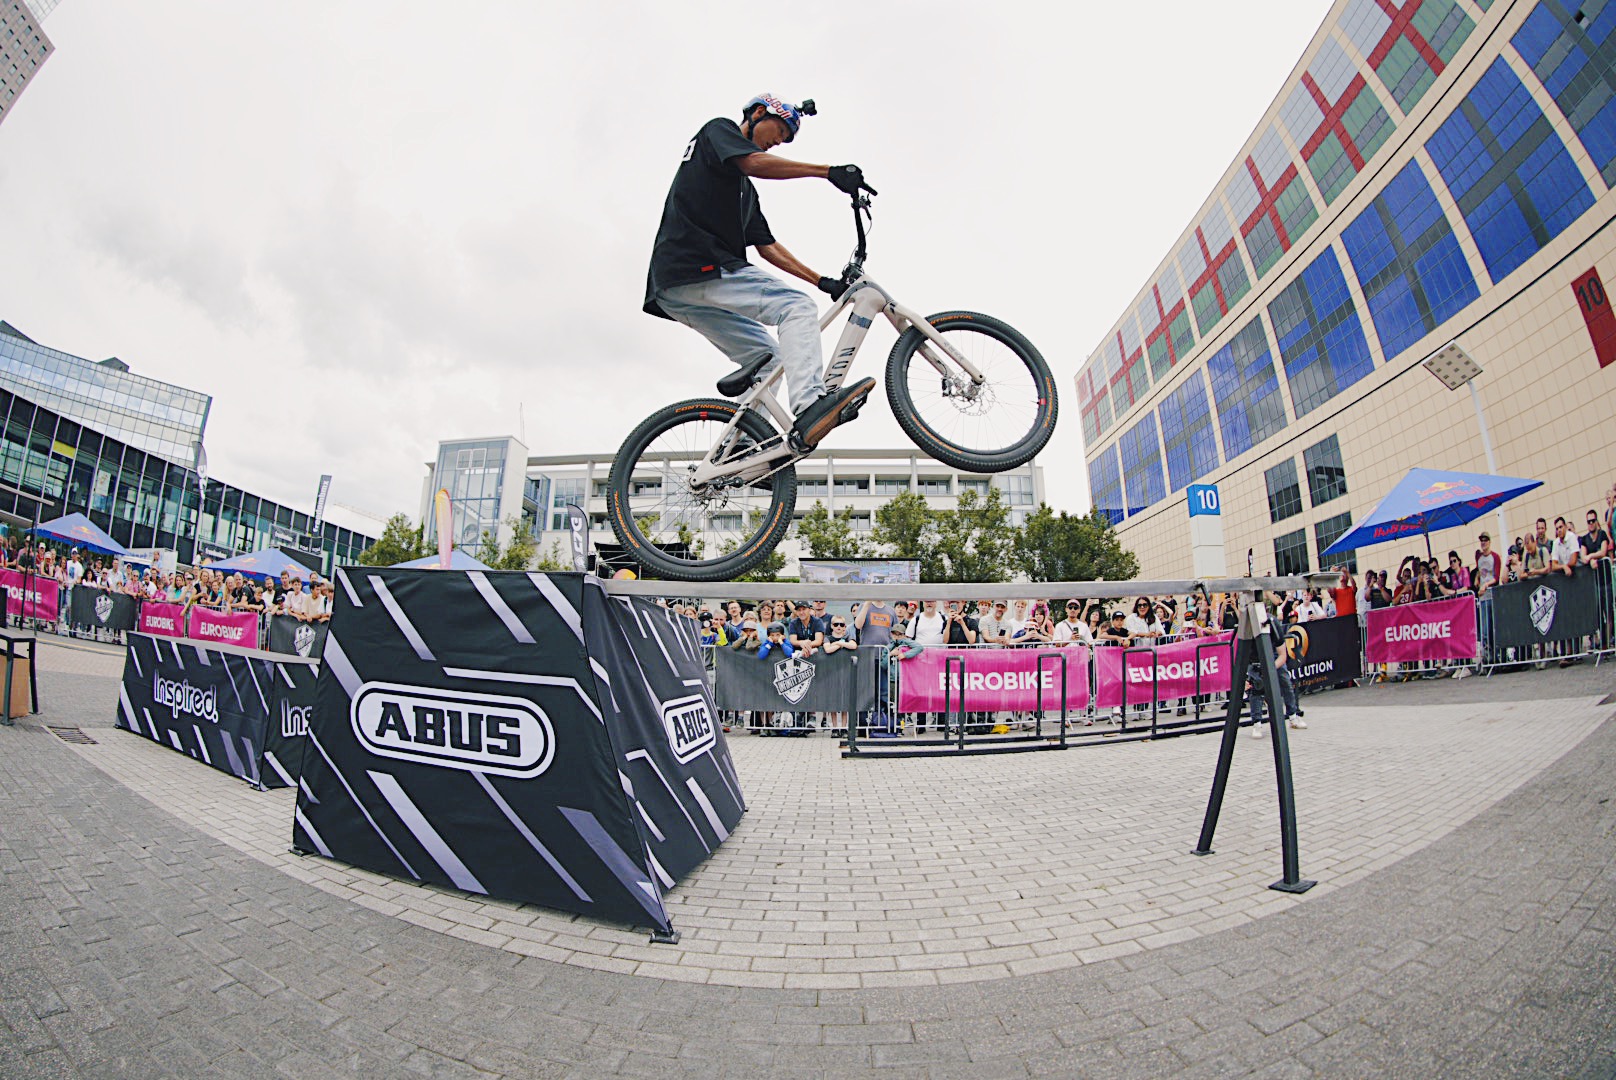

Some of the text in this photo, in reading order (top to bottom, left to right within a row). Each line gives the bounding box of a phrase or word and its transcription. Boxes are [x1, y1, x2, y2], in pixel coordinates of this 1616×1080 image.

[1579, 277, 1604, 312] 10
[1197, 489, 1218, 510] 10
[146, 615, 174, 631] EUROBIKE
[200, 621, 243, 641] EUROBIKE
[1385, 620, 1451, 643] EUROBIKE
[796, 667, 814, 684] STREET
[938, 670, 1054, 691] EUROBIKE
[1128, 655, 1220, 684] EUROBKE
[375, 700, 522, 759] ABUS
[671, 707, 711, 748] ABUS
